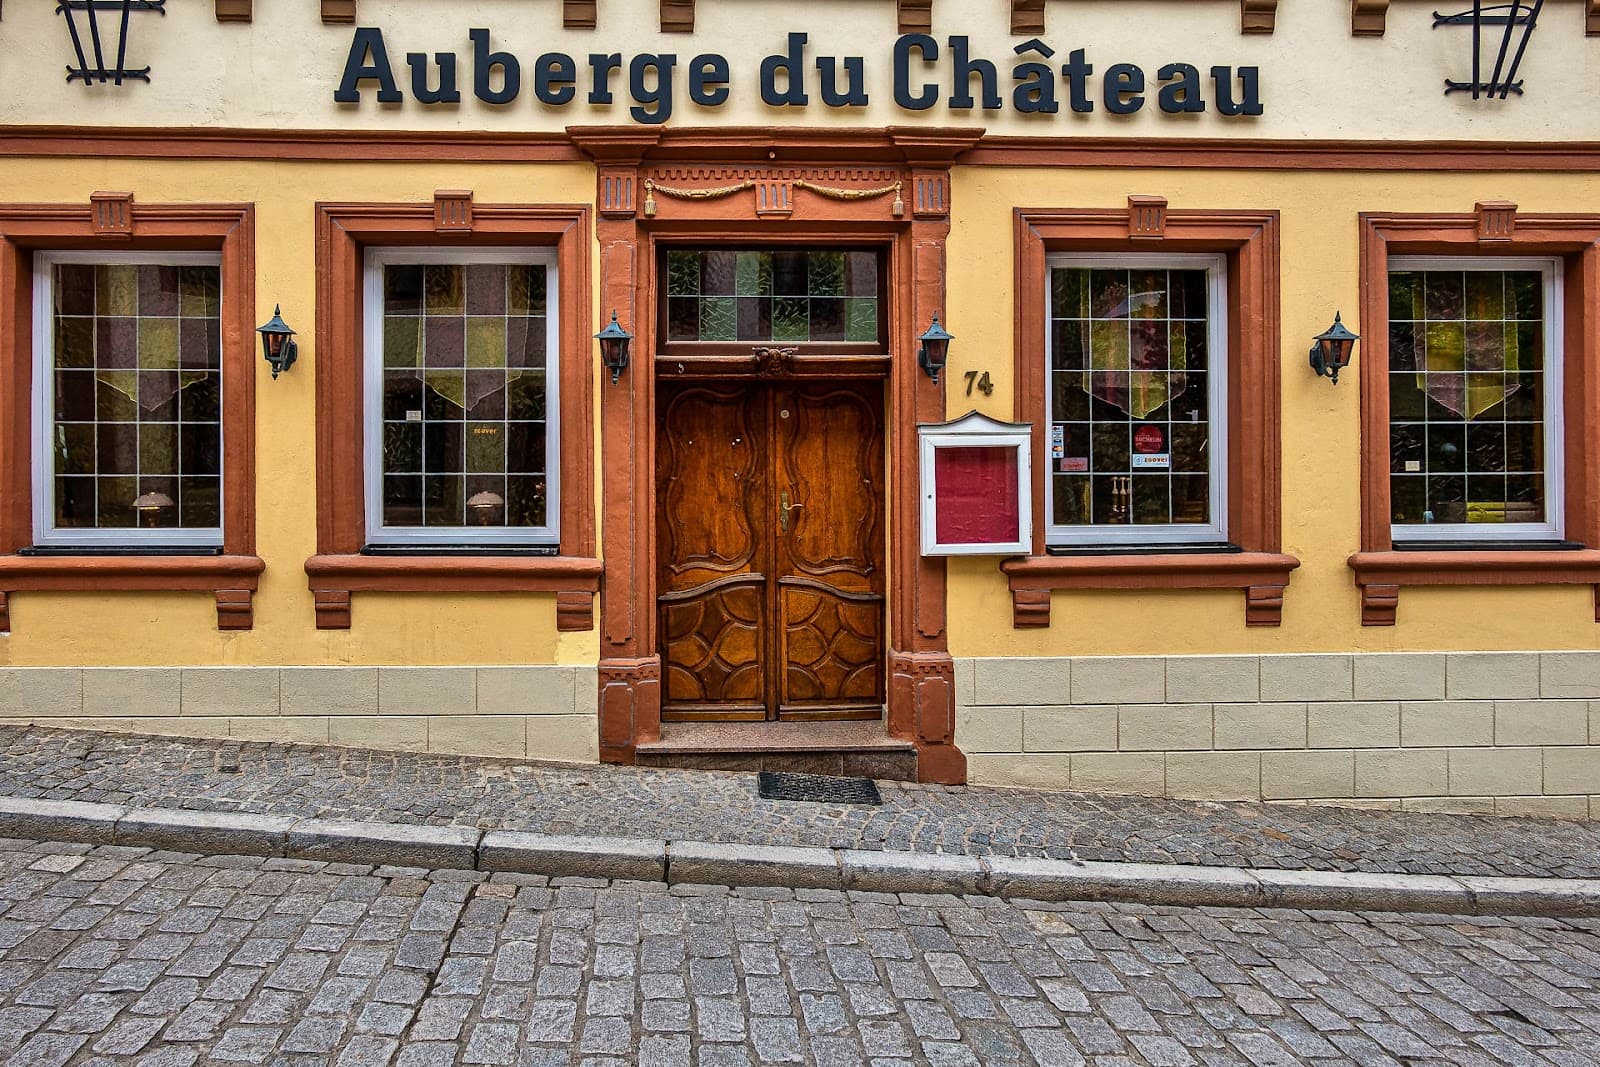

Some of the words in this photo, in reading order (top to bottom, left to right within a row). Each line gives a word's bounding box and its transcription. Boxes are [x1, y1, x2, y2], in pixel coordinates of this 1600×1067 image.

[333, 27, 730, 125] Auberge
[759, 32, 869, 108] du
[894, 26, 1264, 118] Château
[964, 370, 993, 396] 74
